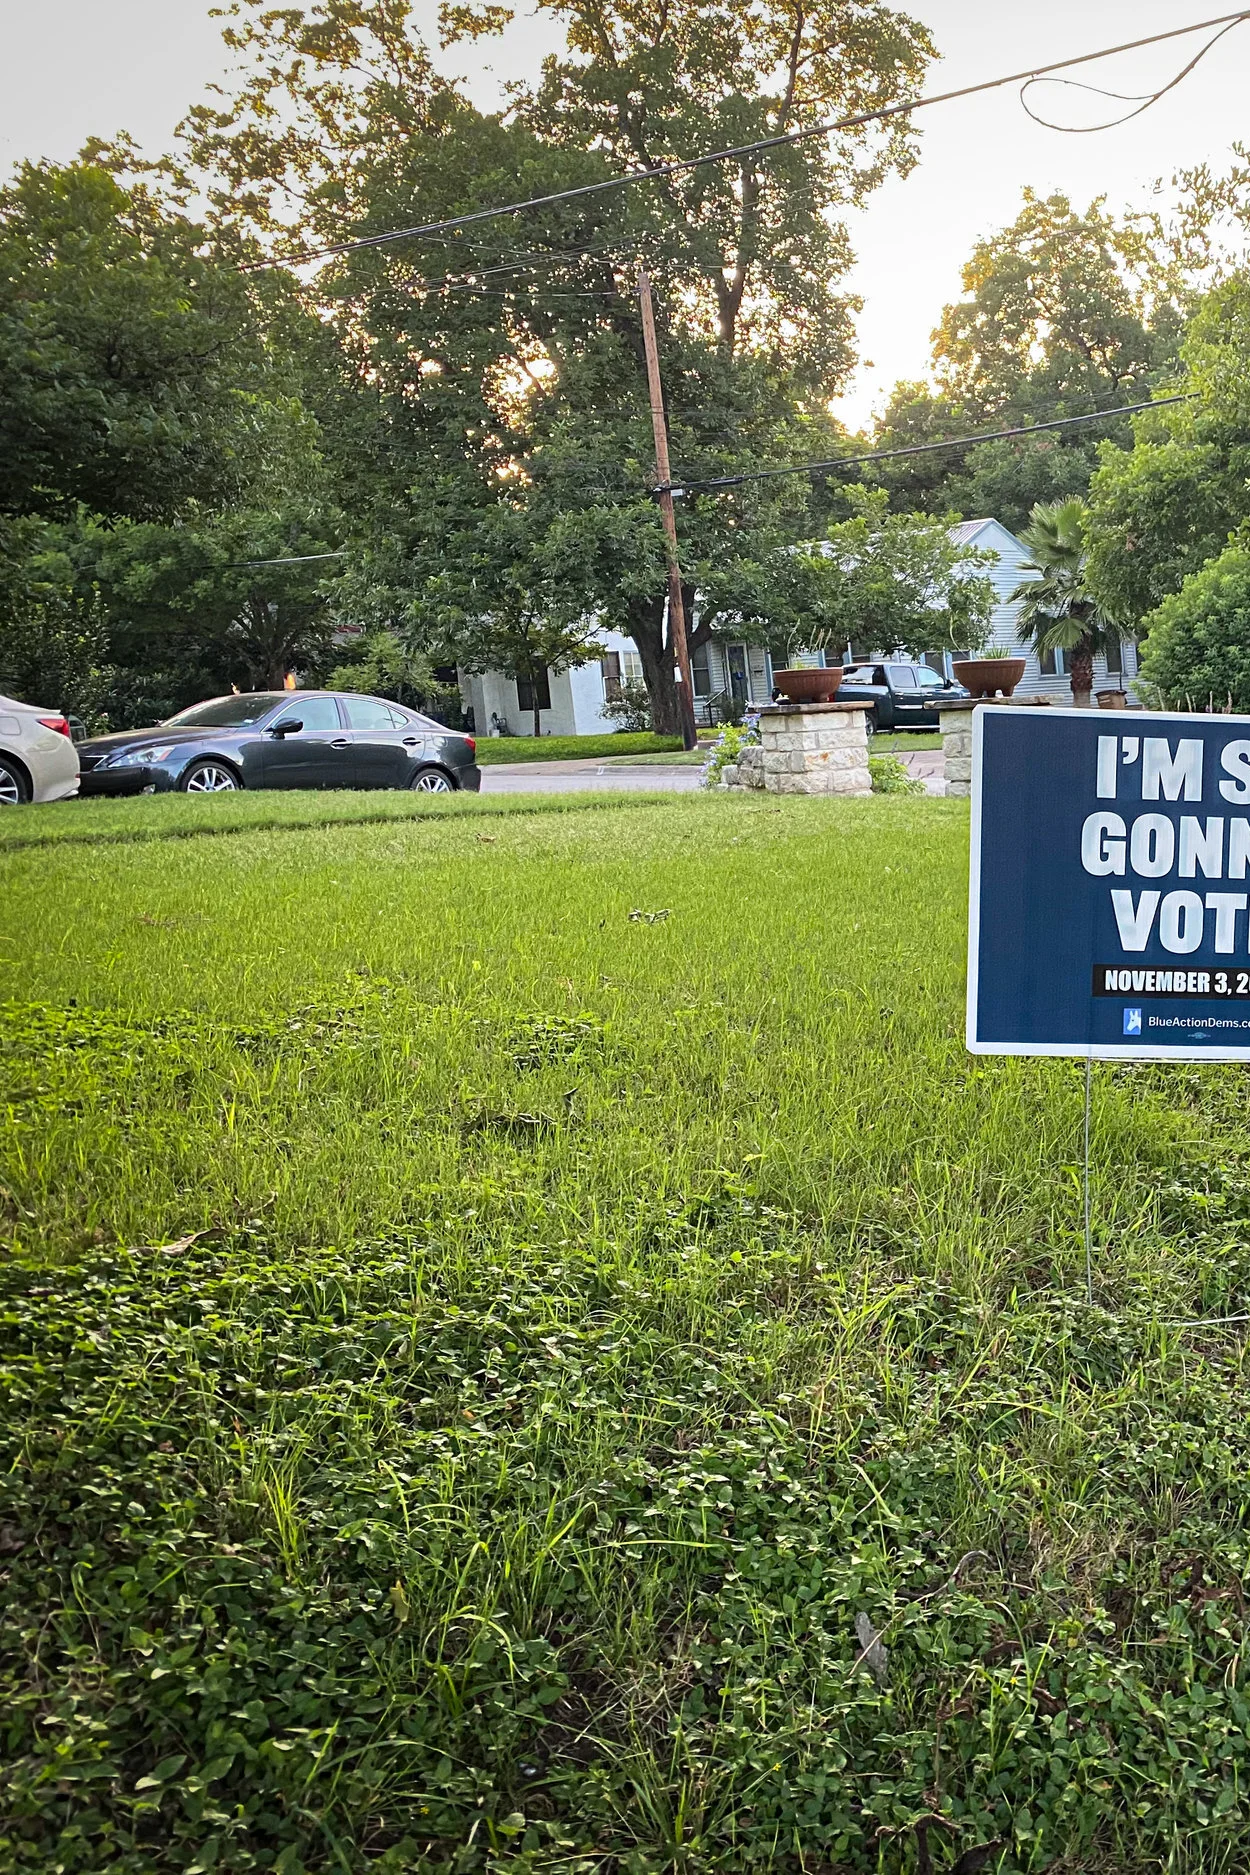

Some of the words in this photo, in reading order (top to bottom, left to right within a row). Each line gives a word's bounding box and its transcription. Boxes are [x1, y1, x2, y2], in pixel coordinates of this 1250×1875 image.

[1097, 736, 1203, 801] I'M
[1105, 969, 1210, 992] NOVEMBER
[1214, 972, 1232, 995] 3,
